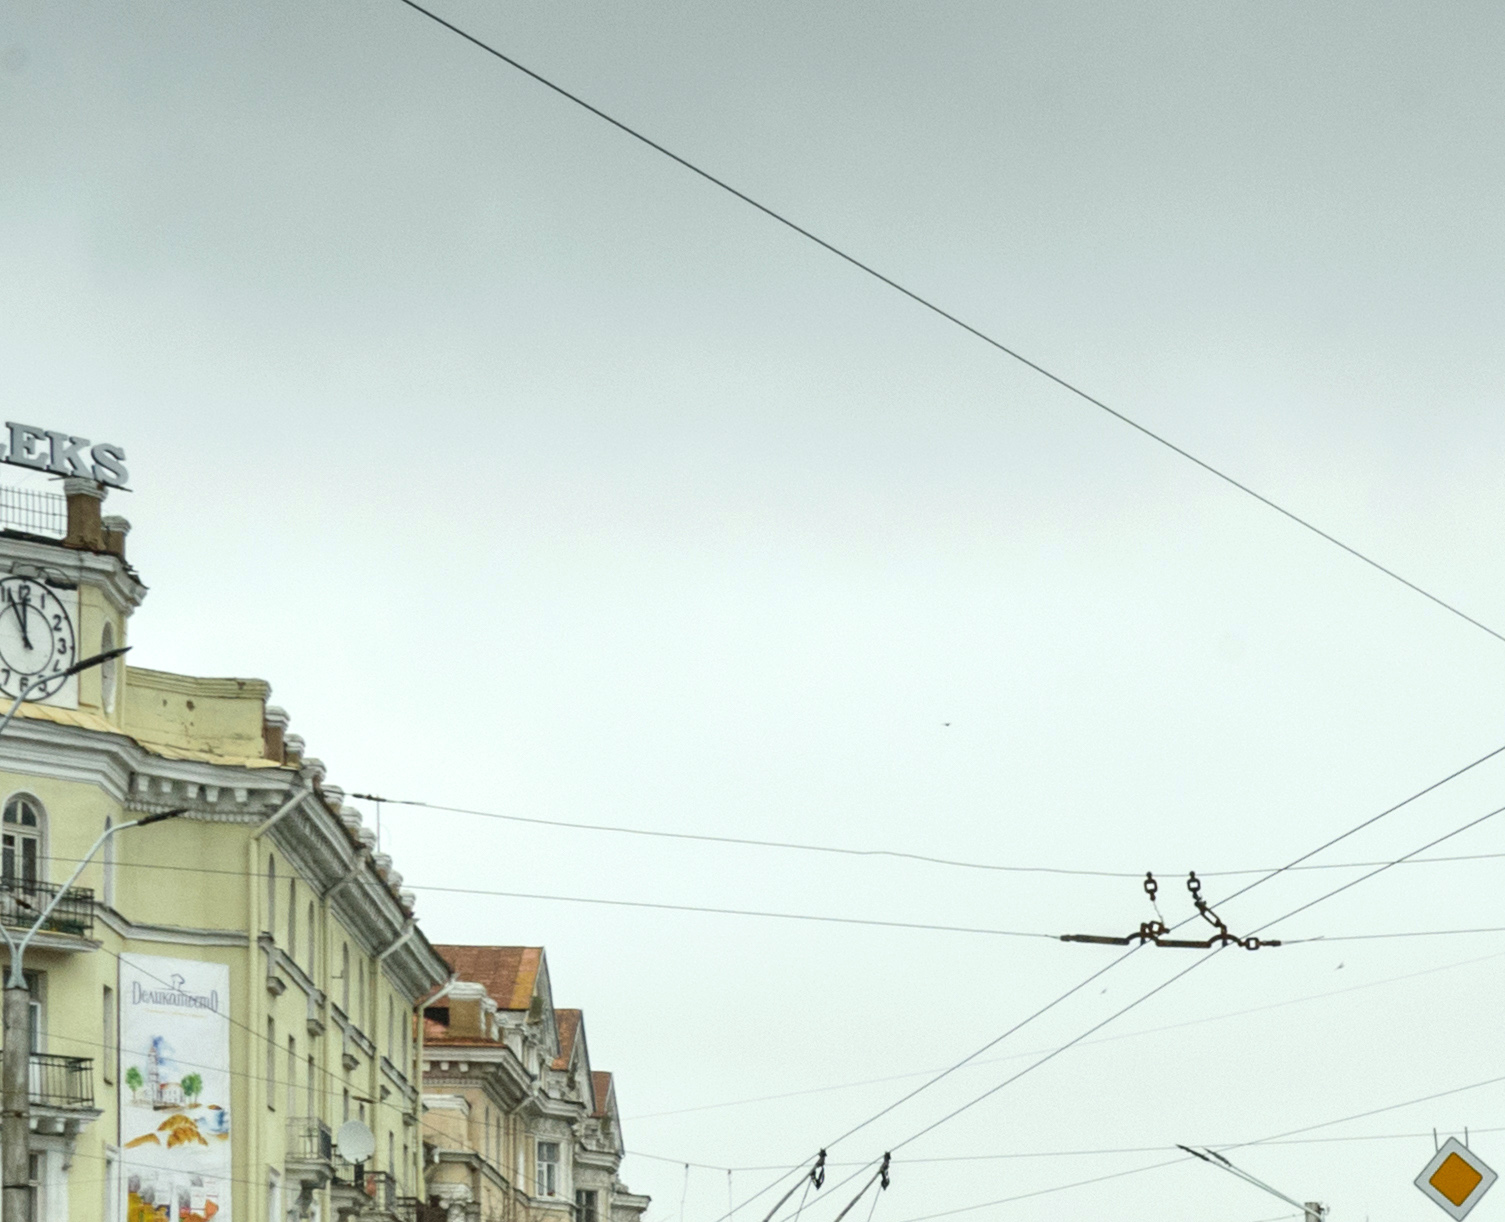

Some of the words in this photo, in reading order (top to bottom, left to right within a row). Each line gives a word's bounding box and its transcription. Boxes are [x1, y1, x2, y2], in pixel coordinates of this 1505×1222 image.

[0, 420, 130, 488] EKS
[53, 614, 62, 632] 2
[57, 638, 67, 655] 3
